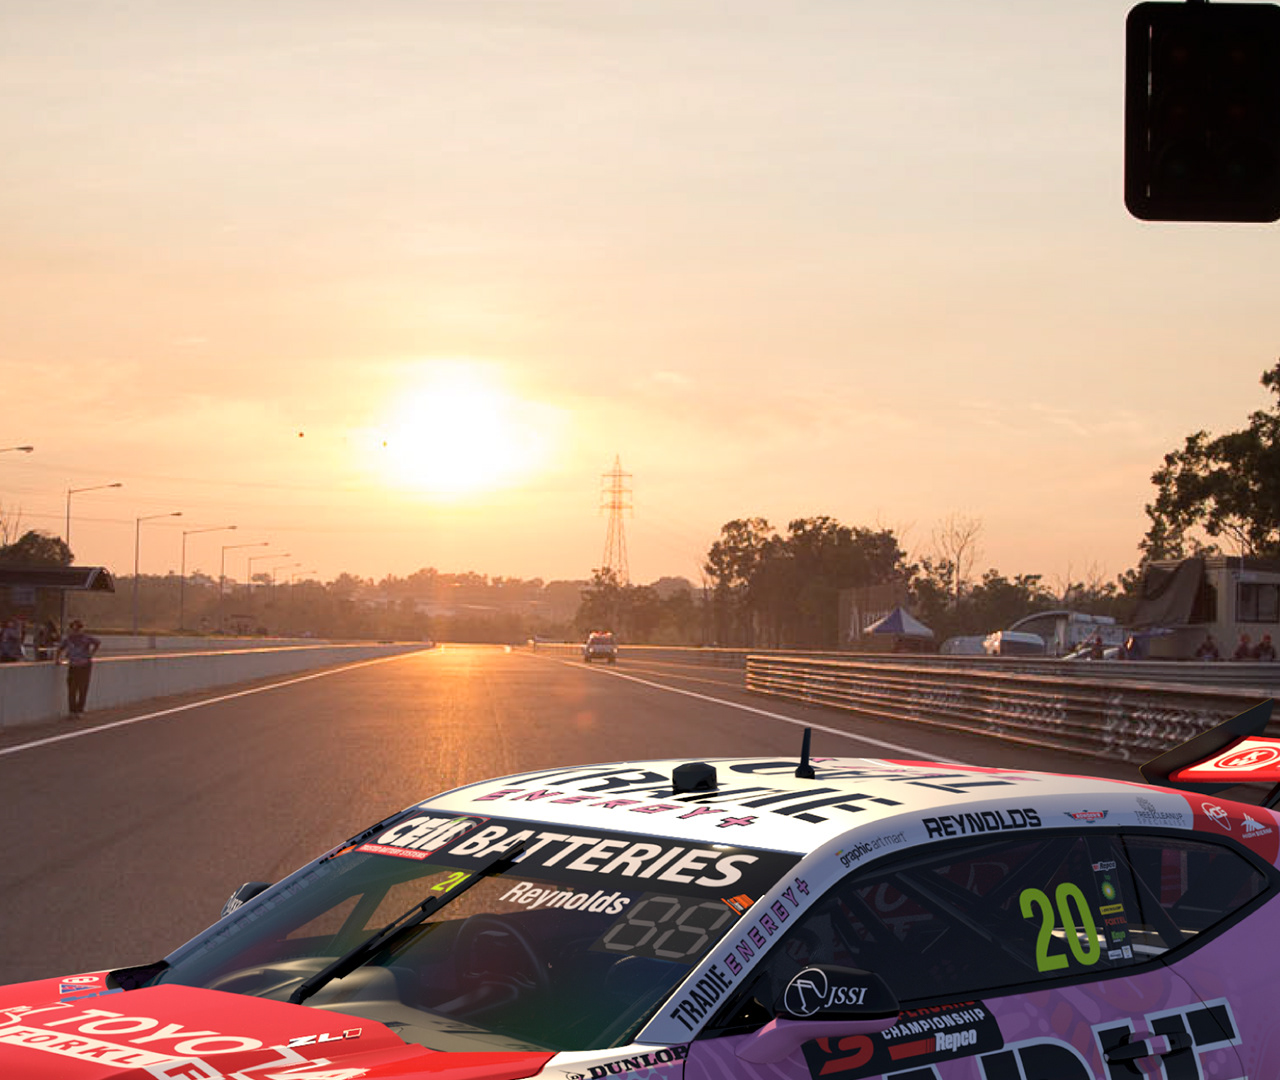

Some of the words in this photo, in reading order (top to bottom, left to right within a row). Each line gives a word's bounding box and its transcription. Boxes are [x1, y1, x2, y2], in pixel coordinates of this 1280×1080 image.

[923, 808, 1041, 839] REYNOLDS
[448, 825, 759, 888] BATTERIES
[839, 842, 873, 868] graphic
[499, 881, 631, 916] Reynolds
[1020, 882, 1101, 972] 20
[671, 964, 733, 1032] TRADIE
[824, 986, 868, 1008] JSSI
[881, 1007, 986, 1041] CHAMPIONSHIP
[934, 1028, 978, 1053] Repco
[587, 1045, 688, 1080] DUNLOP
